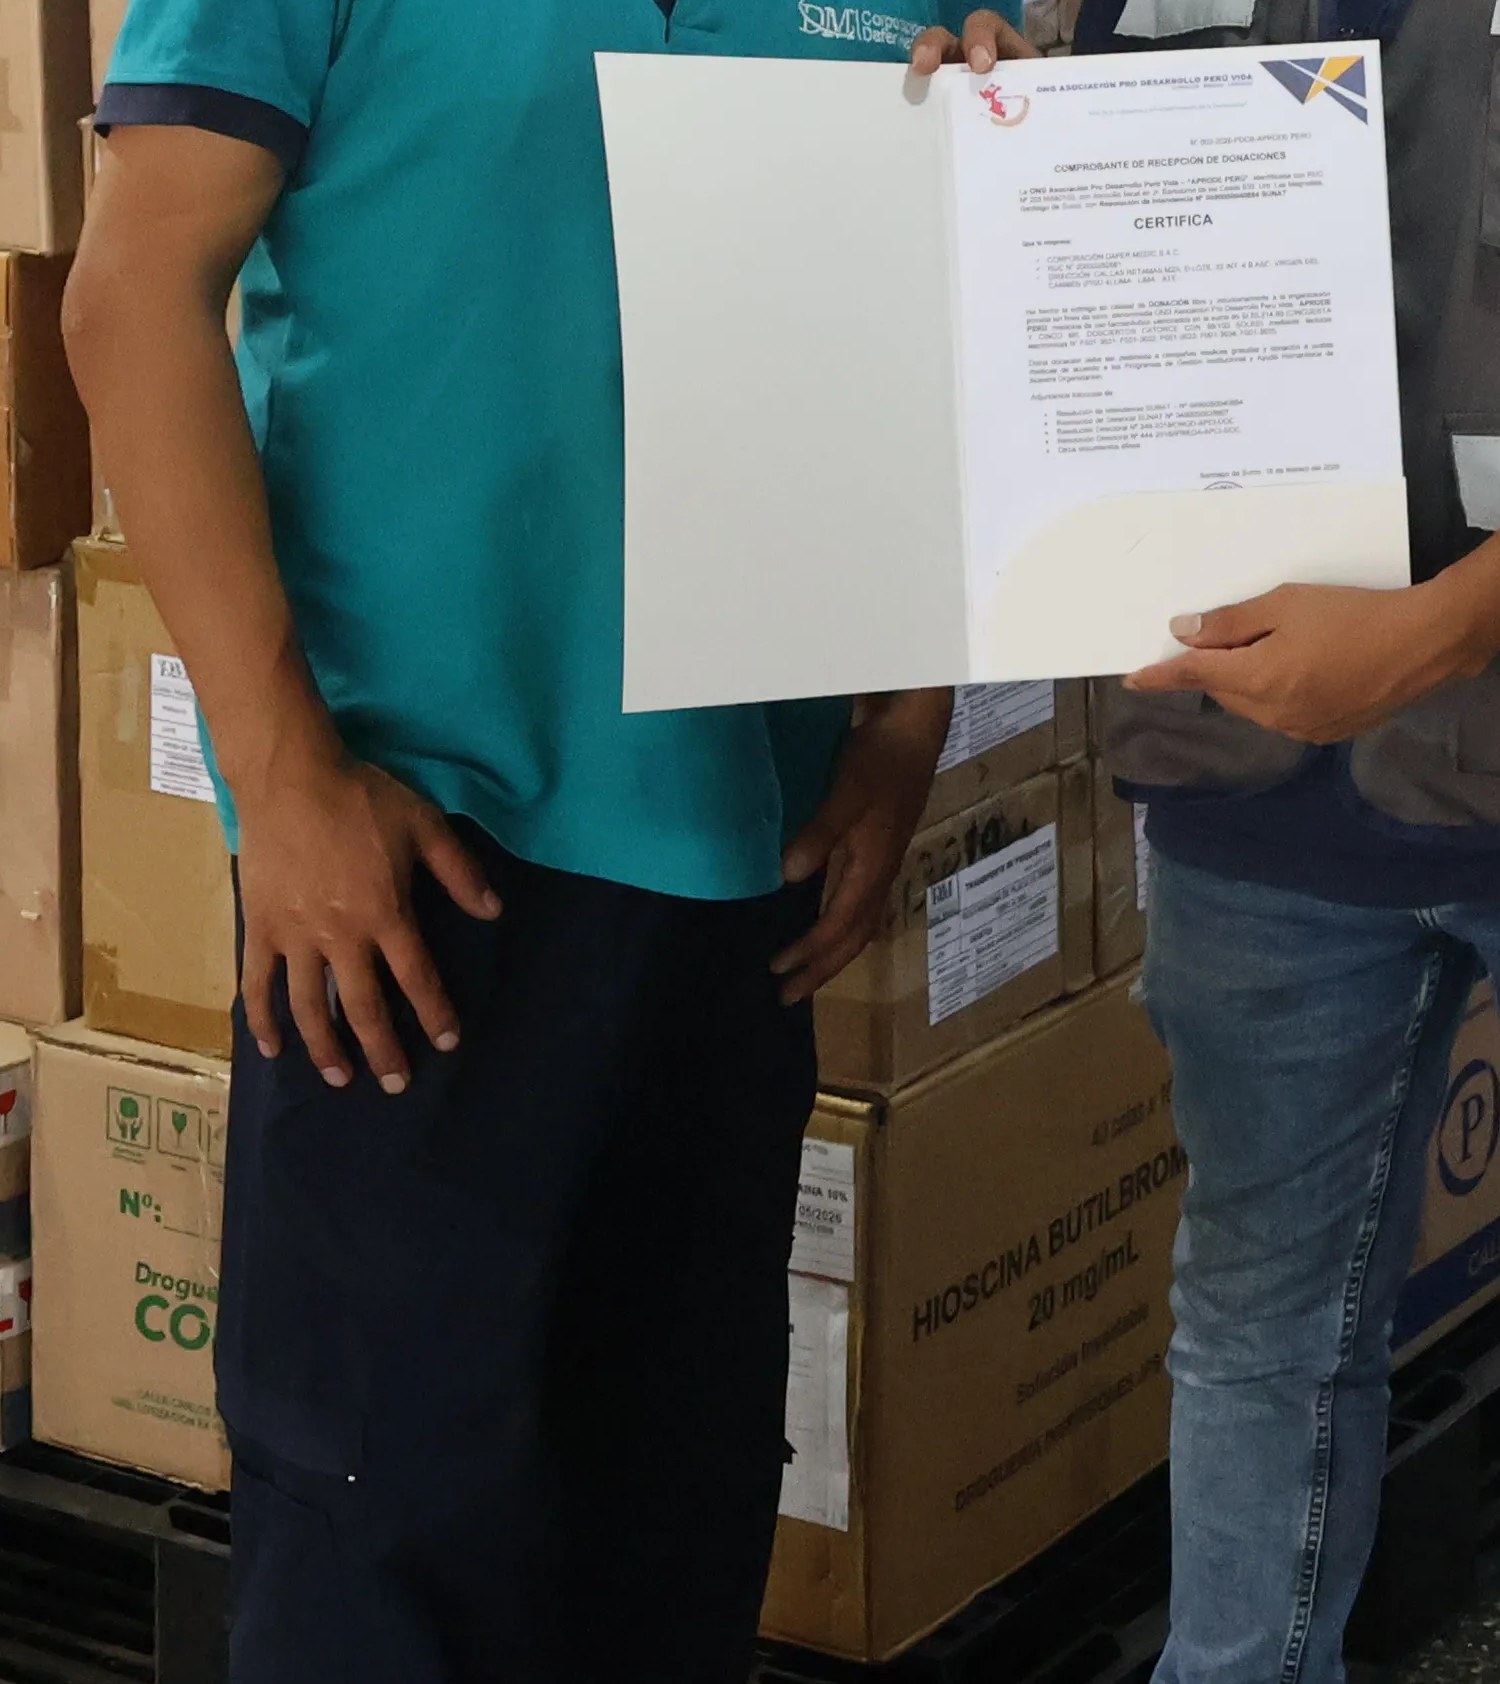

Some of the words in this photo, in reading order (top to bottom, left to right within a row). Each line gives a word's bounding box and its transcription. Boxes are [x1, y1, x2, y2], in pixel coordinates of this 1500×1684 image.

[1119, 79, 1137, 88] PRO
[1140, 77, 1201, 87] DESARROLLO
[1231, 73, 1253, 81] VIDA
[1054, 160, 1129, 173] COMPROBANTE
[1132, 159, 1145, 169] DE
[1206, 154, 1219, 164] DE
[1222, 151, 1286, 163] DONACIONES
[1134, 214, 1213, 230] CERTIFICA
[911, 1232, 1043, 1343] HIOSCINA
[1047, 1145, 1189, 1257] BUTILBROM
[1028, 1284, 1055, 1333] 20
[1062, 1231, 1140, 1307] mg/mL
[135, 1294, 211, 1351] CO
